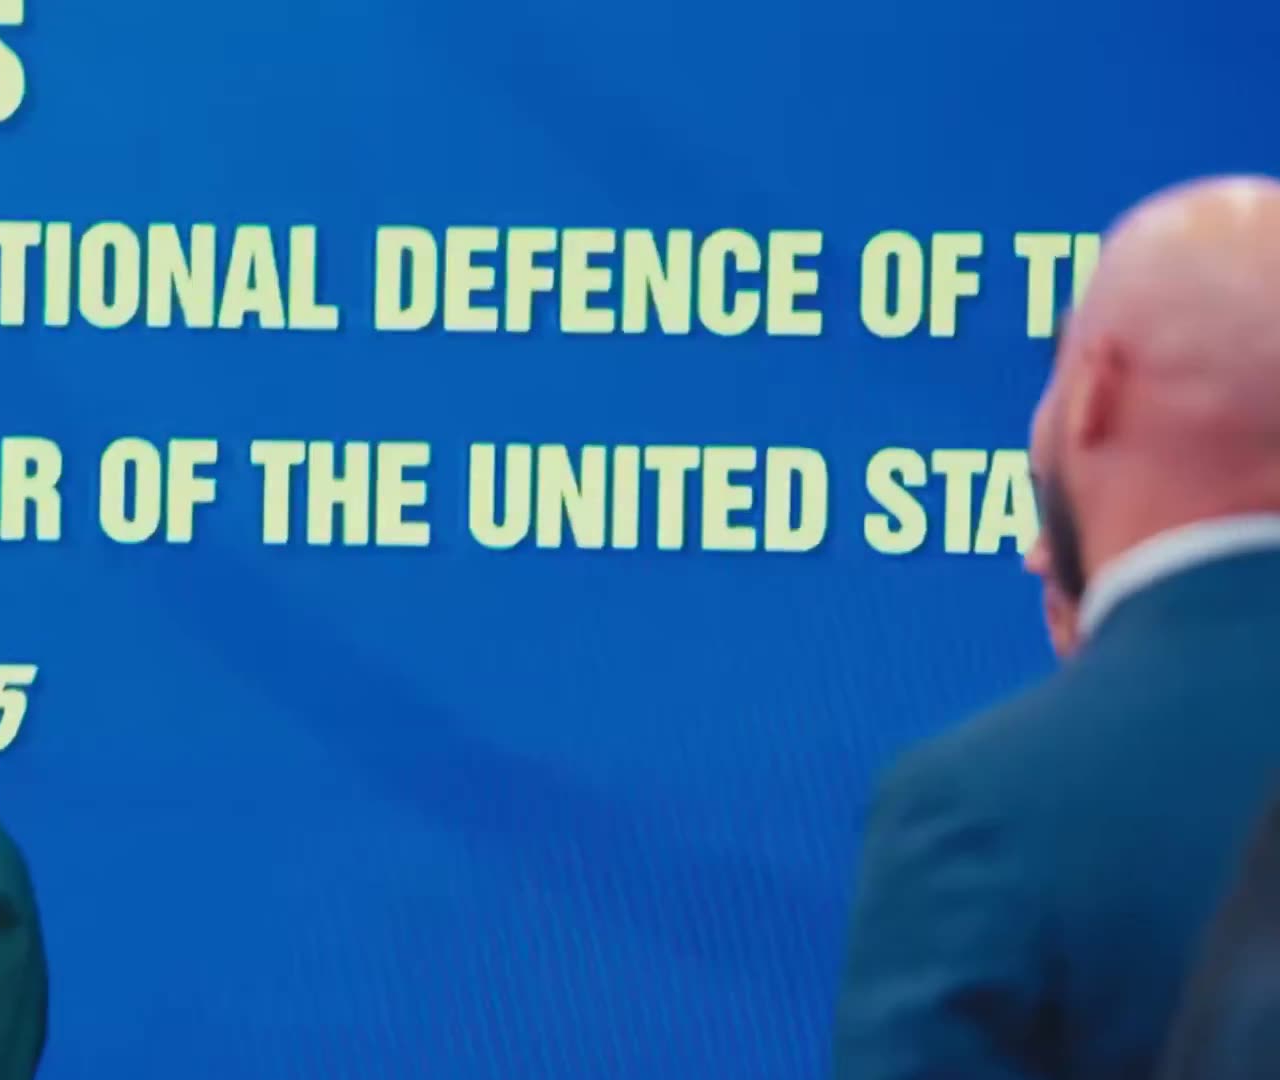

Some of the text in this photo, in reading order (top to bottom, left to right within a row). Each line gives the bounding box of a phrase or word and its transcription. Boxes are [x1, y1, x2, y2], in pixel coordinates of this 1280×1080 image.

[374, 226, 823, 336] DEFENCE
[860, 231, 983, 338] OF
[98, 437, 219, 543] OF
[249, 440, 431, 547] THE
[468, 444, 829, 552] UNITED
